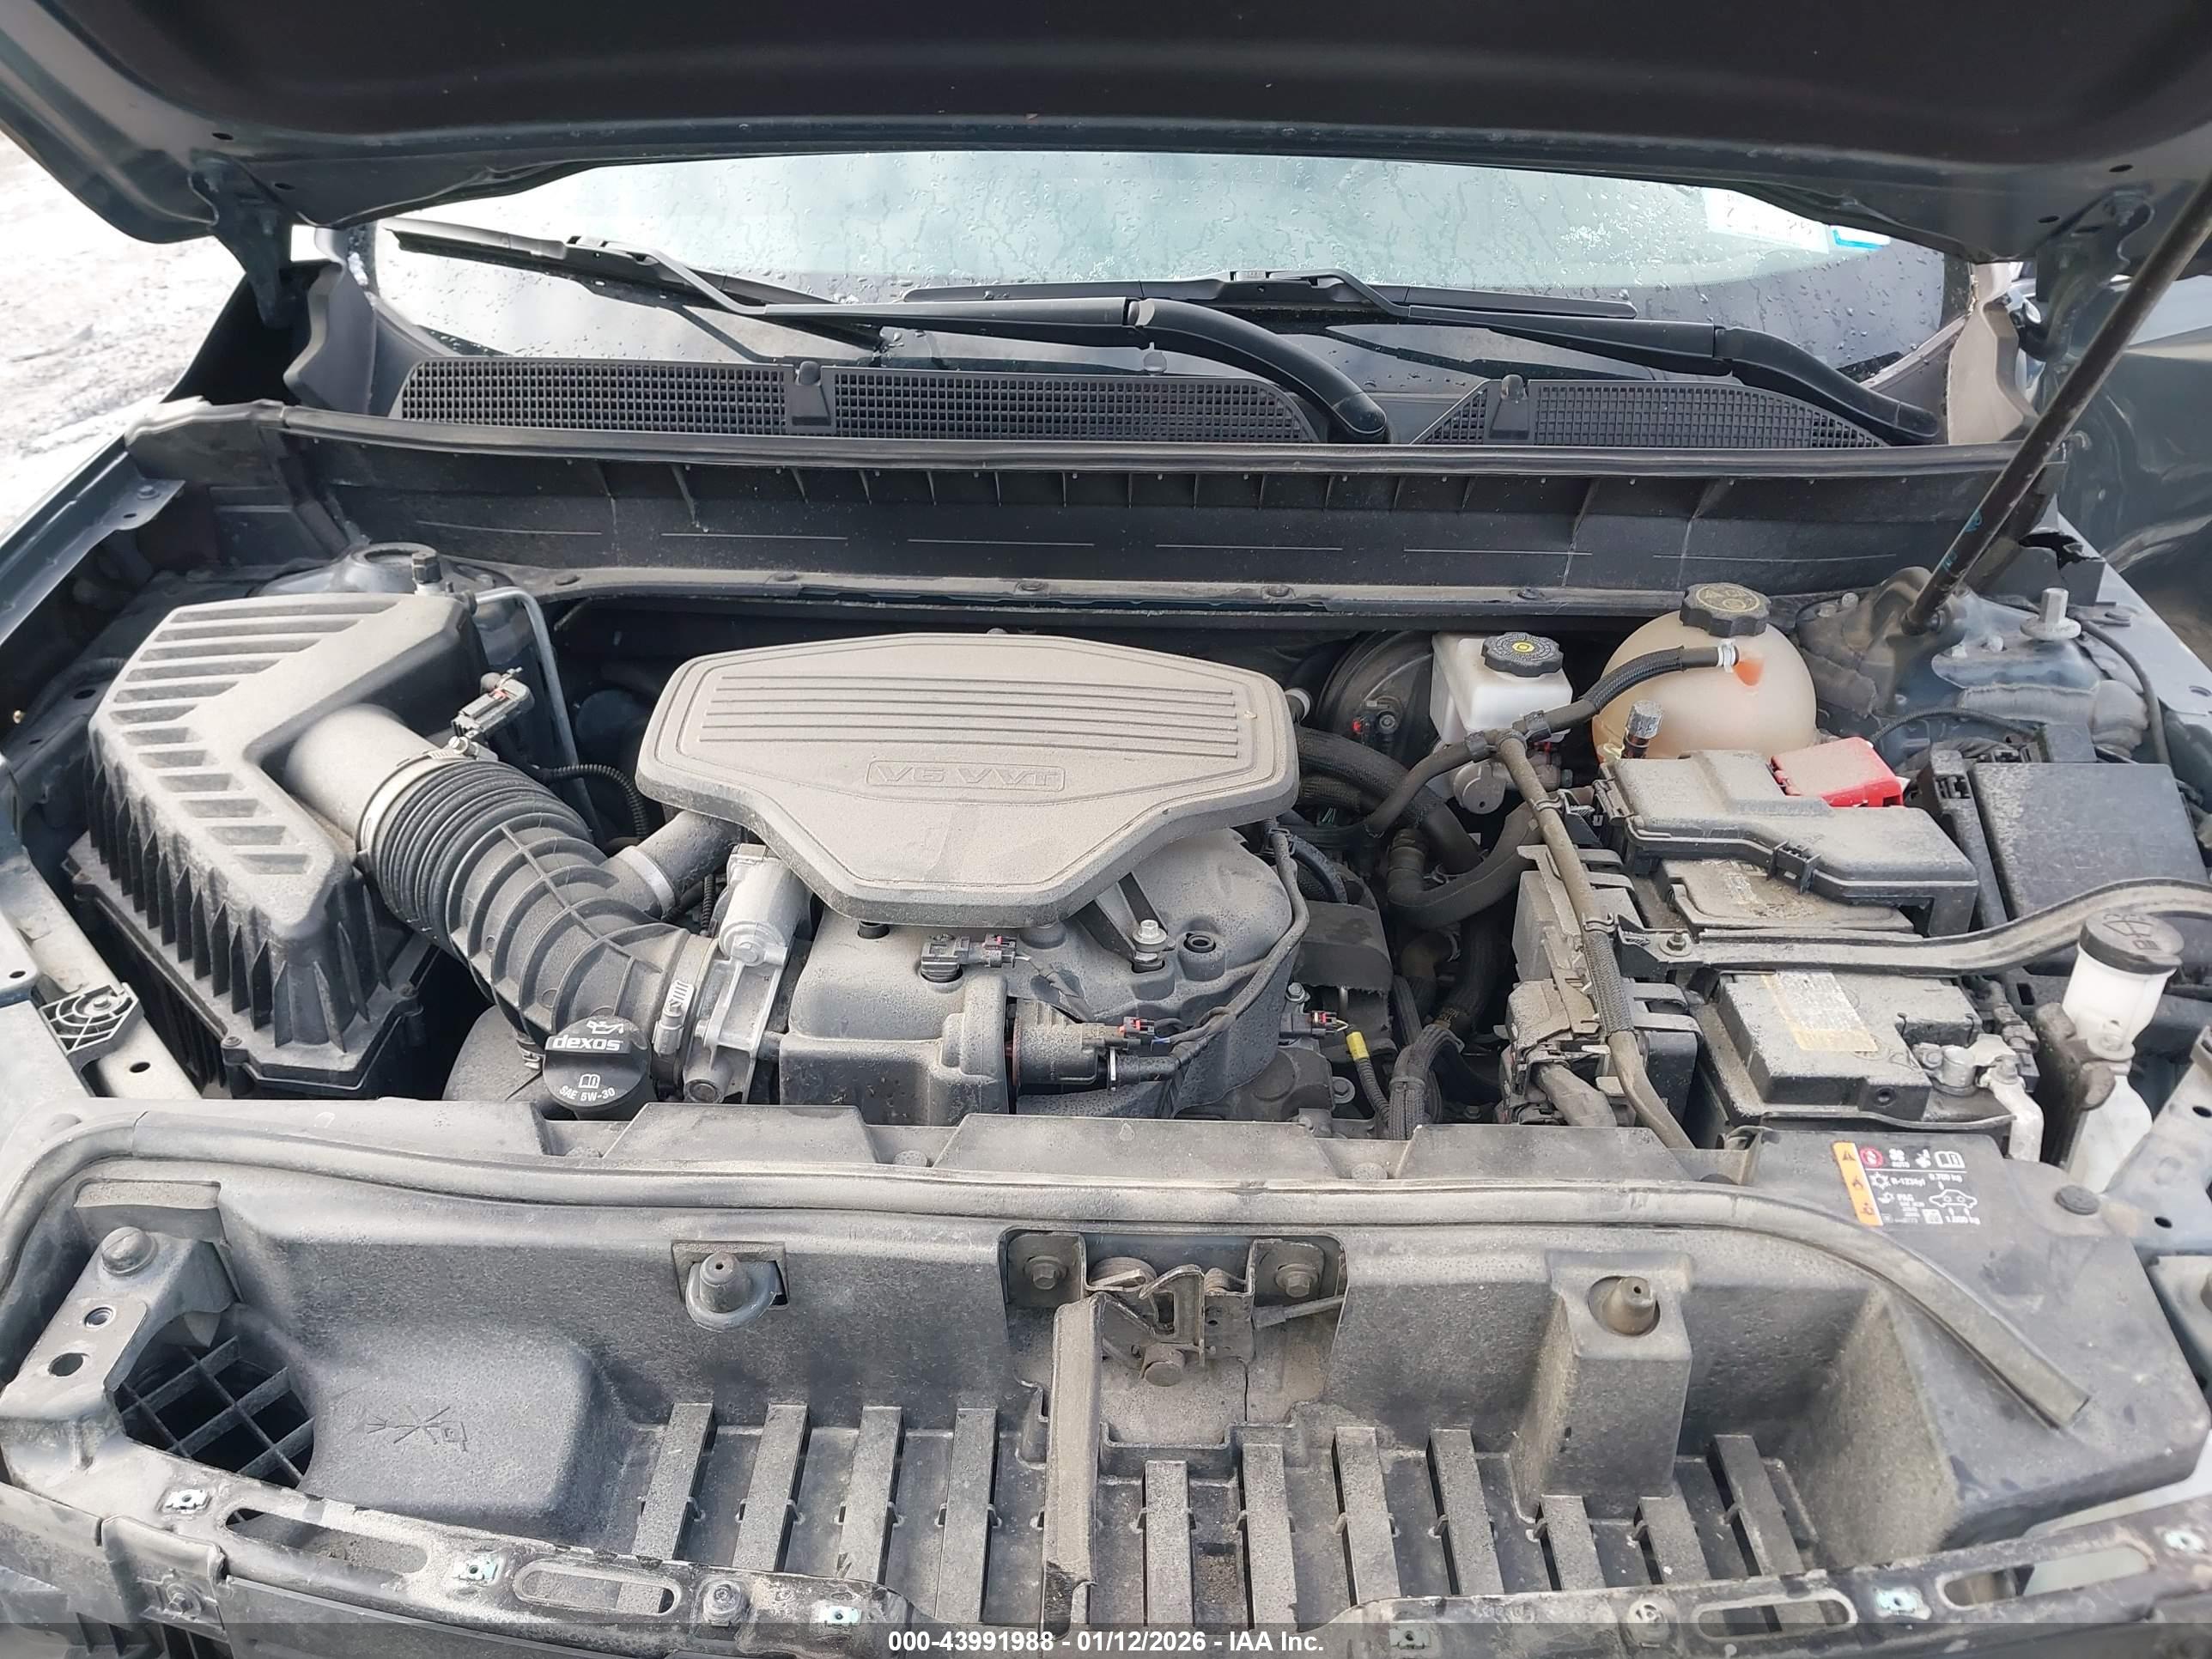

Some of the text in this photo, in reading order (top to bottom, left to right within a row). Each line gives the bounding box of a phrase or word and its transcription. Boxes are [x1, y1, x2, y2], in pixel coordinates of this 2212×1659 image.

[876, 764, 1061, 787] V6 VVT
[552, 1034, 621, 1051] dexos
[559, 1085, 616, 1102] SAE 5W-30
